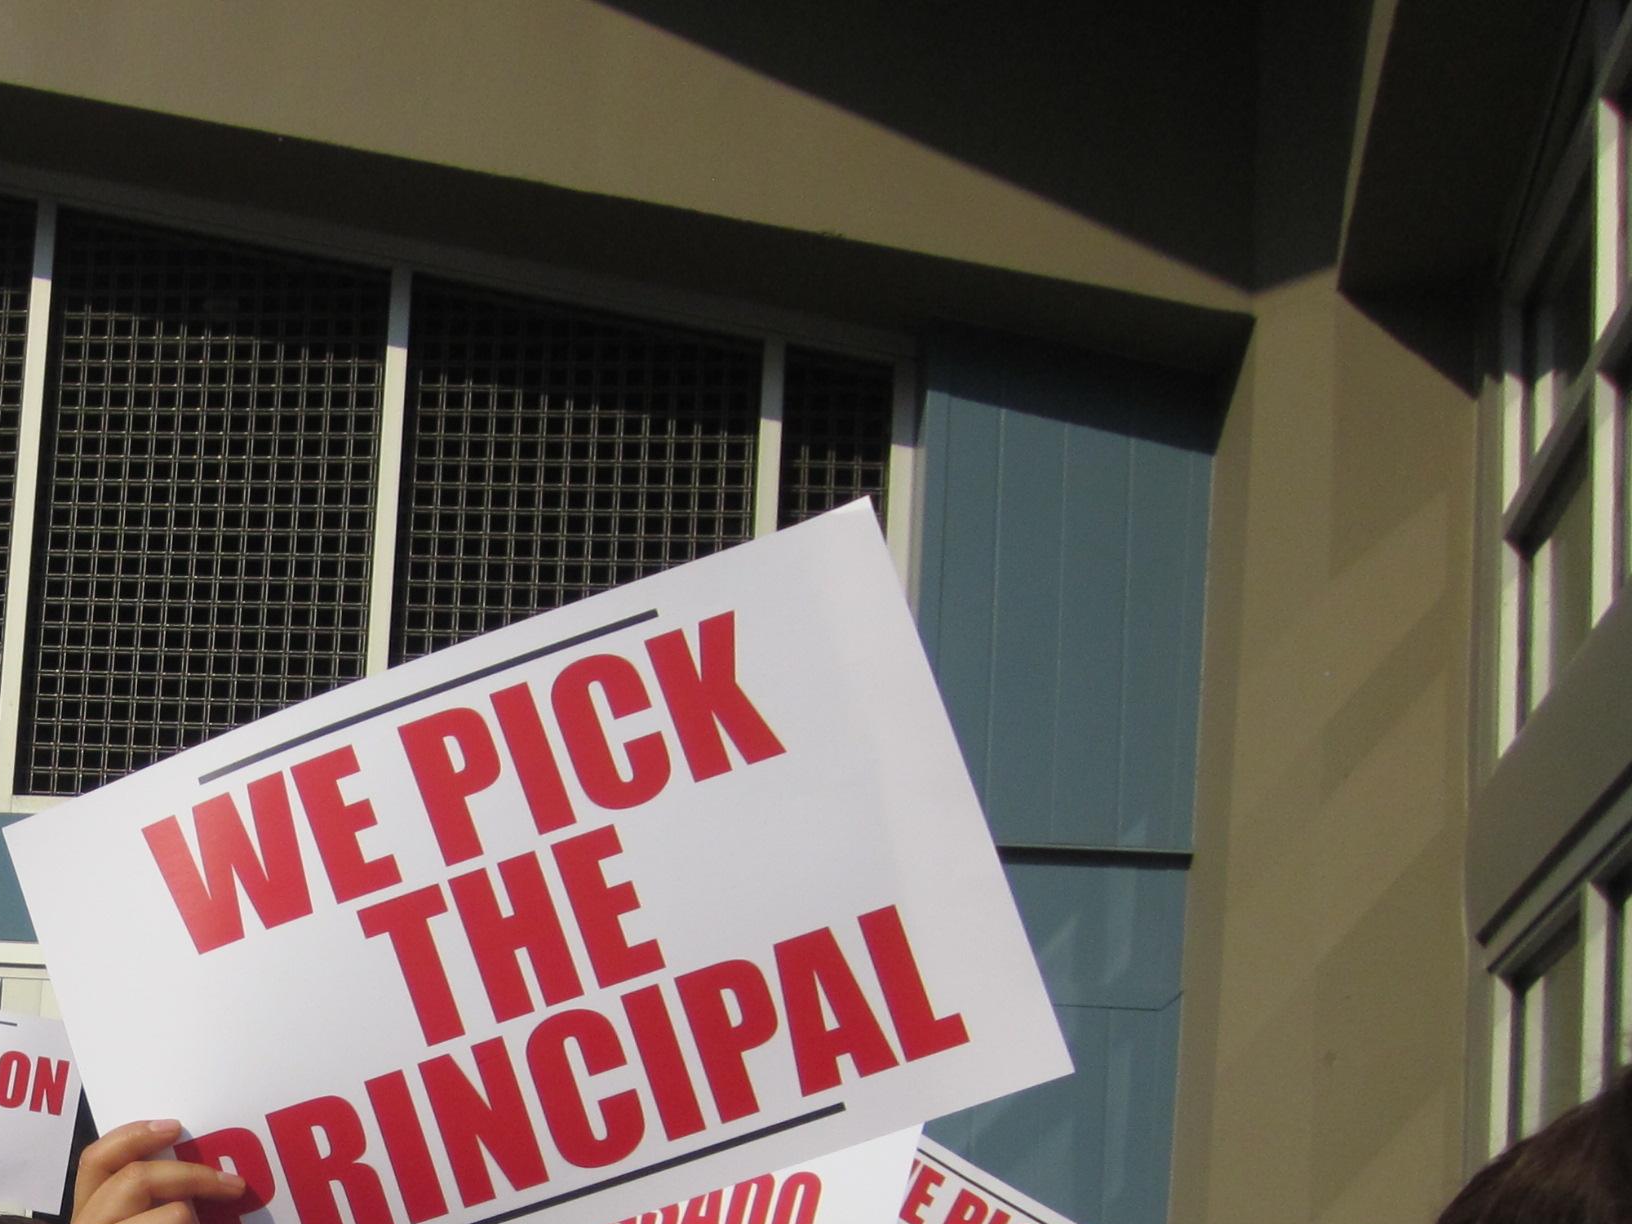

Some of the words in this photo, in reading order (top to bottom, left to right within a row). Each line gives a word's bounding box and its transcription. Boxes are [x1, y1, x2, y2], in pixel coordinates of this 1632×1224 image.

[141, 743, 402, 955] WE
[397, 609, 786, 867] PICK
[356, 823, 666, 1047] THE
